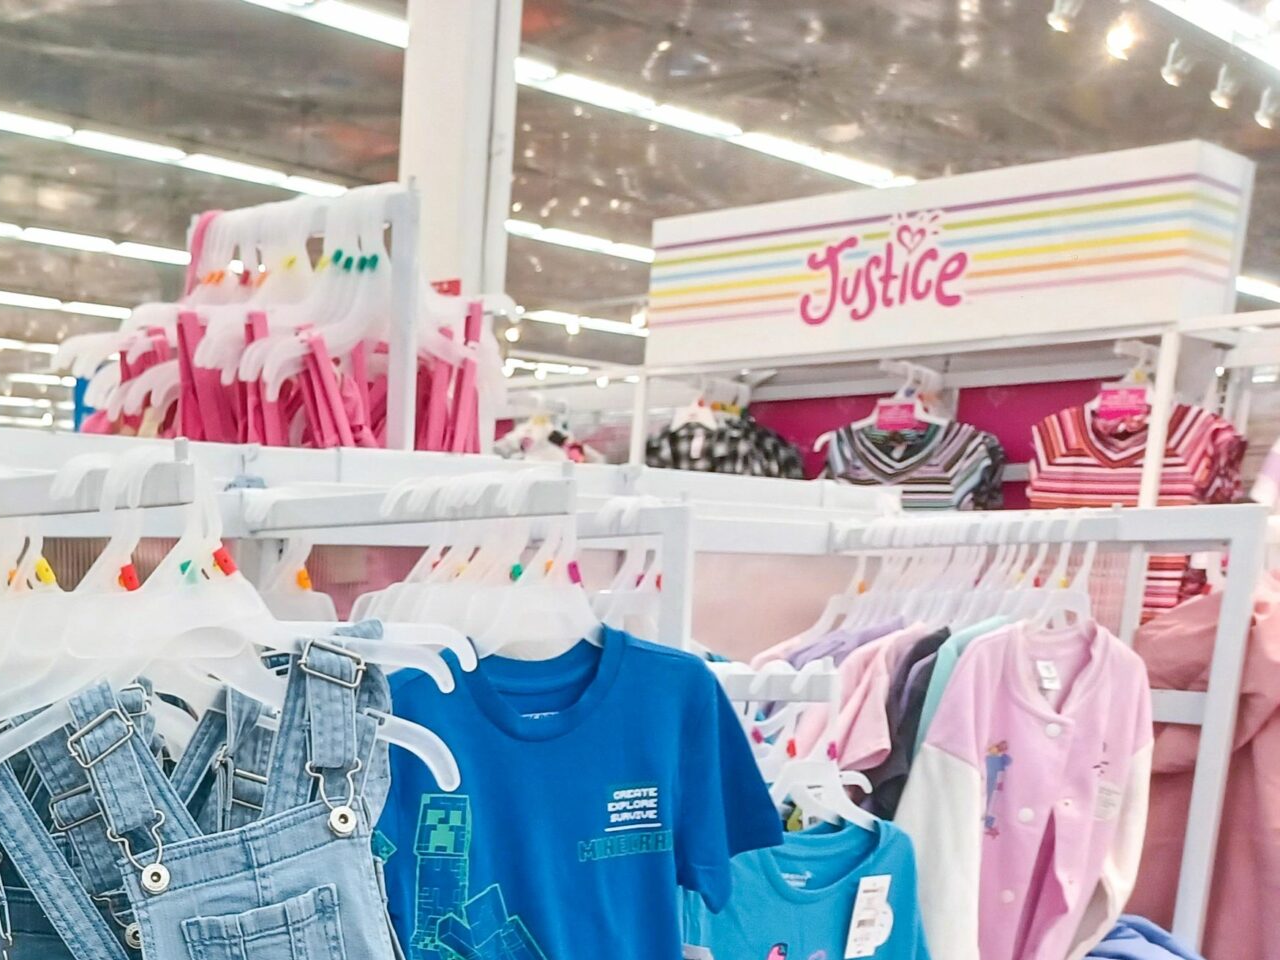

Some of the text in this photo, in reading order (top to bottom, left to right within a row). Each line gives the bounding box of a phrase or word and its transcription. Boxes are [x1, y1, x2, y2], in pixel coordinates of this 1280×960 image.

[800, 230, 968, 325] Justice
[613, 787, 658, 800] CREATE
[607, 798, 658, 811] EXPLORE
[610, 809, 658, 823] SURVIVE
